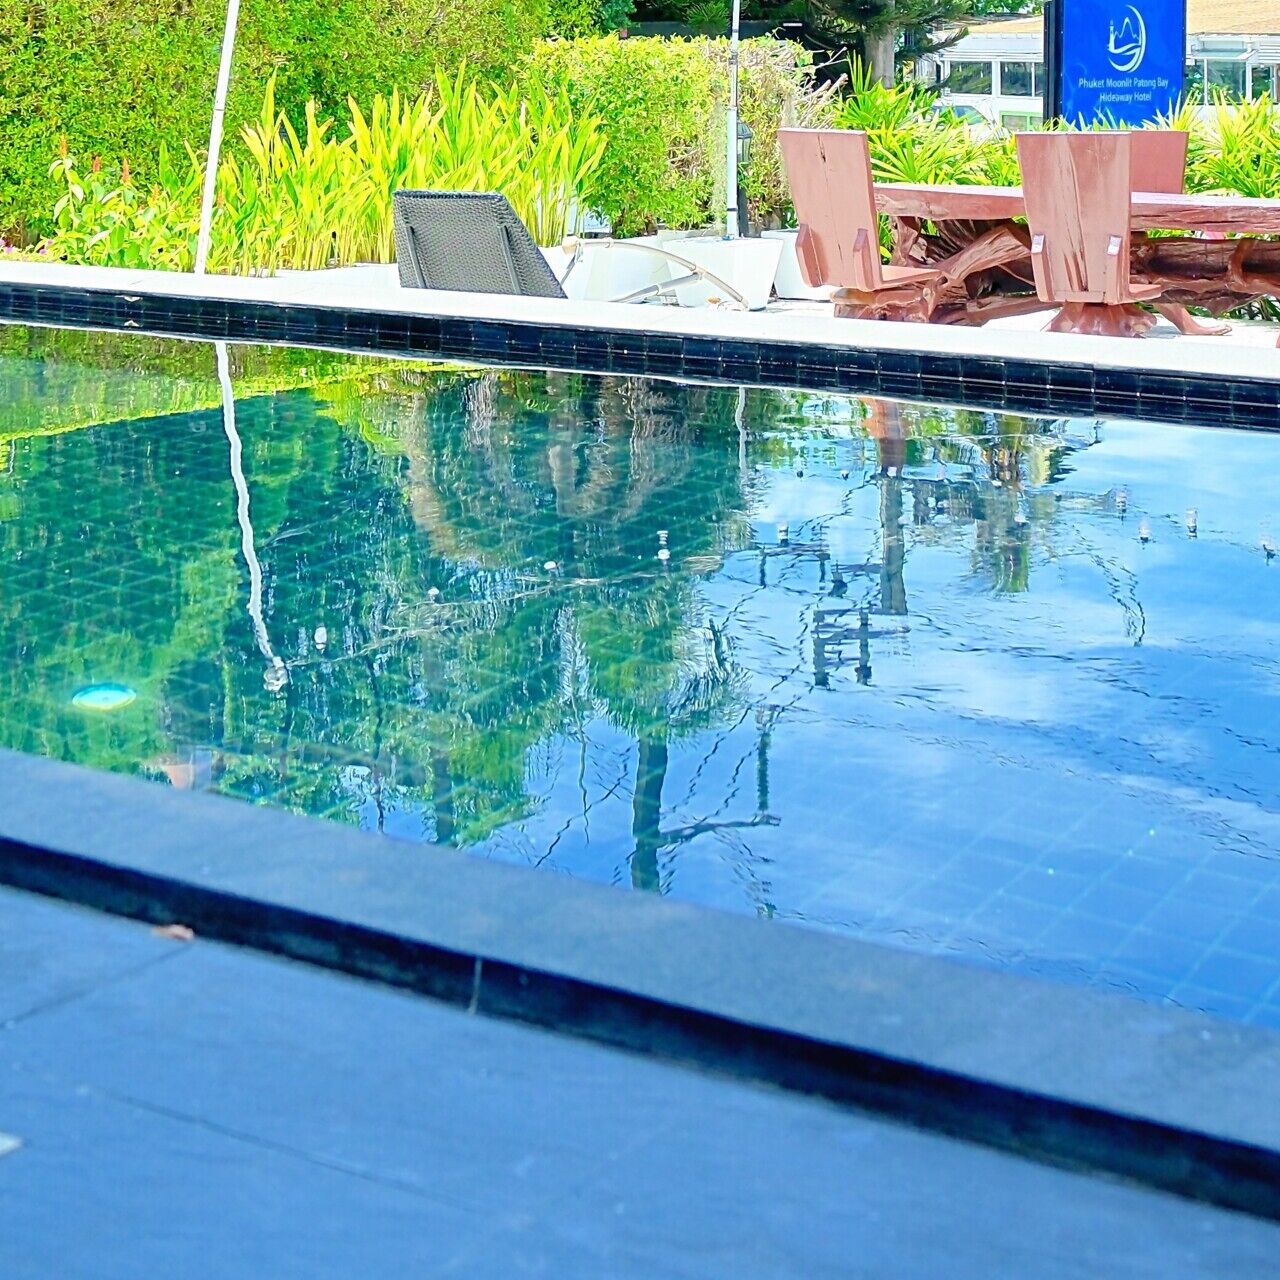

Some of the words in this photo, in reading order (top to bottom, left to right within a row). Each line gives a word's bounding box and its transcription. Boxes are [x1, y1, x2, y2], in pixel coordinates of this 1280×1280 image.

[1079, 77, 1105, 88] Phuket
[1106, 77, 1132, 88] Moonlit
[1133, 77, 1156, 89] Patong
[1157, 77, 1168, 89] Bay
[1100, 92, 1133, 103] Hideaway
[1134, 92, 1151, 101] Hotel
